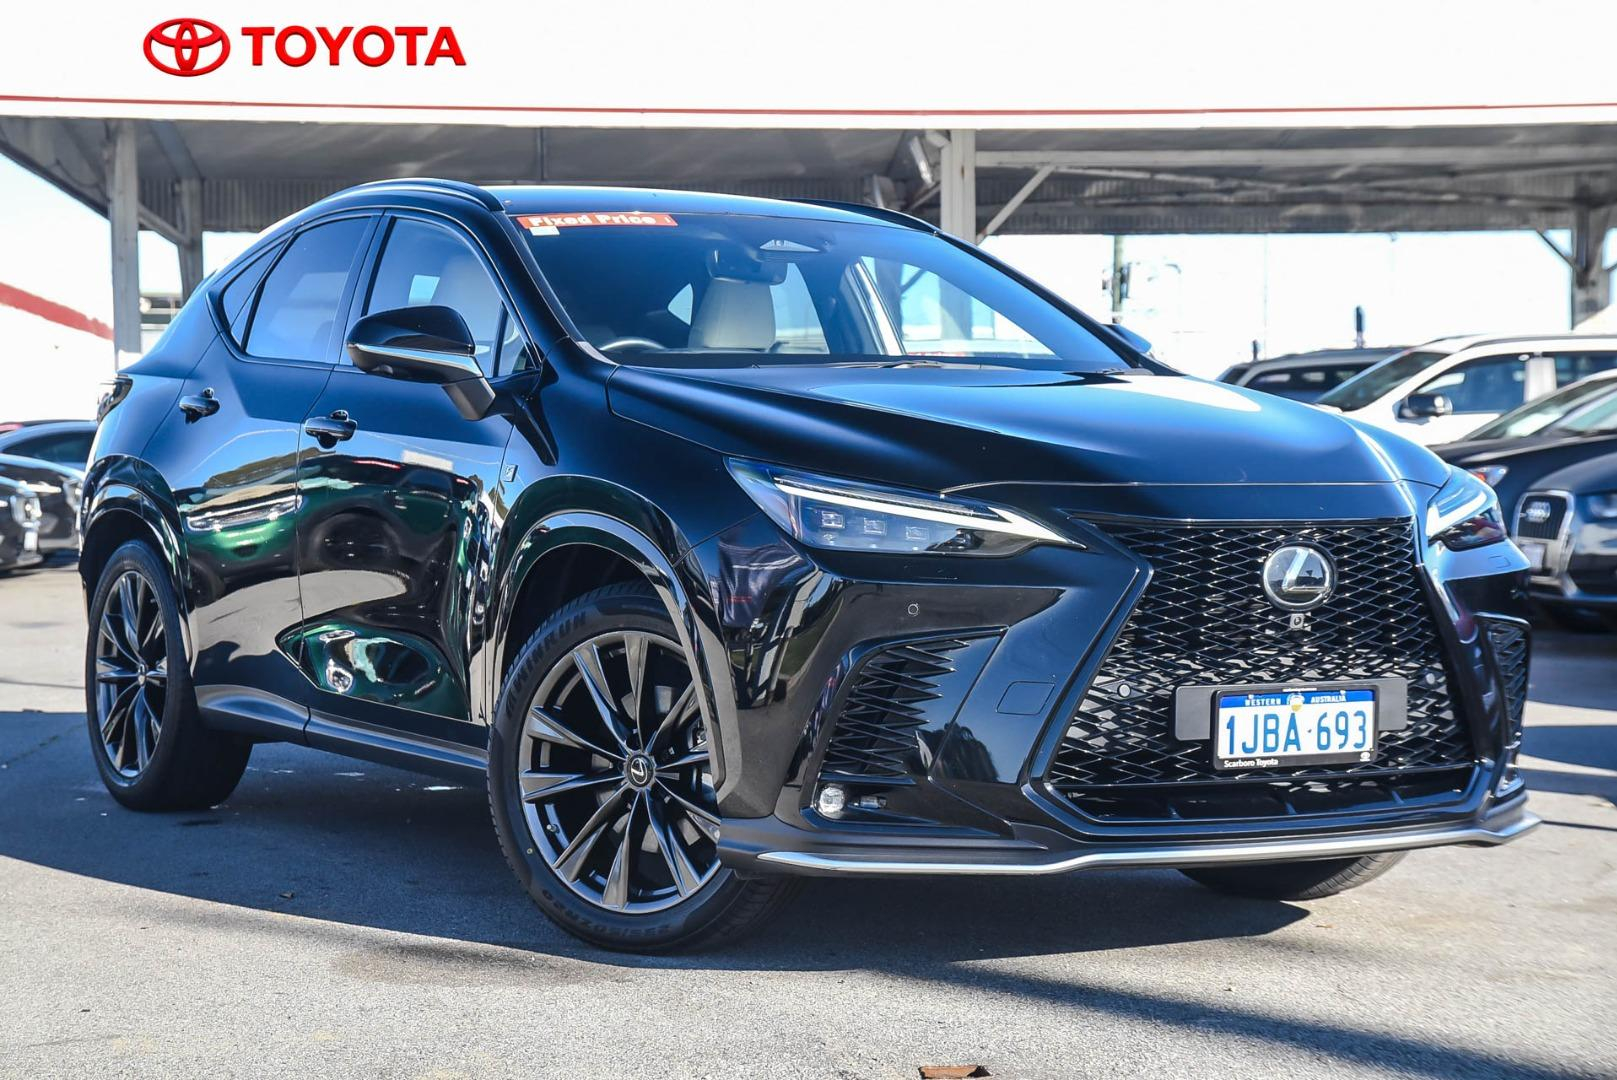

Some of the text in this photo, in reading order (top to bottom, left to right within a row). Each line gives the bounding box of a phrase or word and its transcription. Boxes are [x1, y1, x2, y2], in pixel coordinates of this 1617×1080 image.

[241, 25, 467, 67] TOYOTA
[528, 214, 592, 227] Fixed
[595, 213, 657, 225] Price
[1245, 695, 1347, 707] WESTERN AUSTRALIA
[1226, 710, 1367, 755] 1JBA 693
[1224, 758, 1278, 768] Scarboro Toyota
